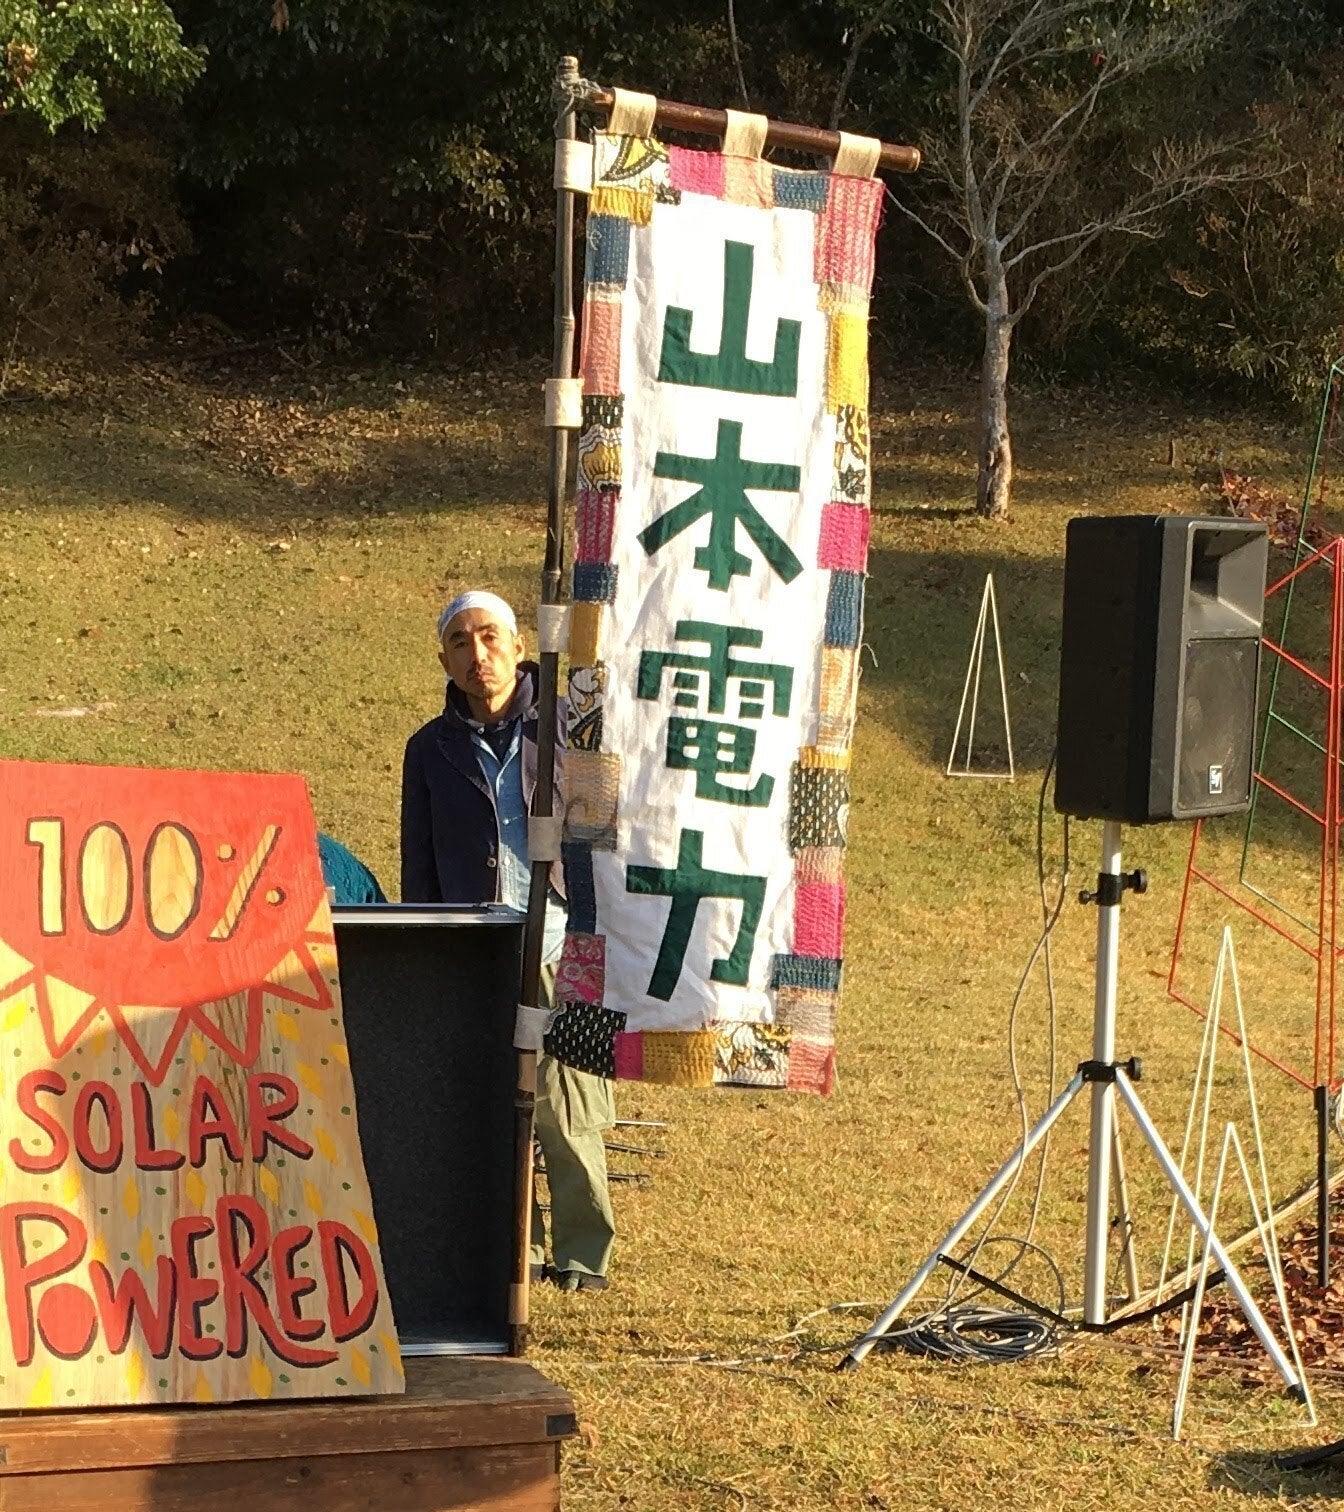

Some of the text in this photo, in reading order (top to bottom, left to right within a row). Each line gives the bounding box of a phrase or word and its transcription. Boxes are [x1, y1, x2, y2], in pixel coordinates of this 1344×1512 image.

[626, 240, 804, 1002] 山本電力
[24, 816, 284, 941] 100%
[8, 1069, 313, 1174] SOLAR
